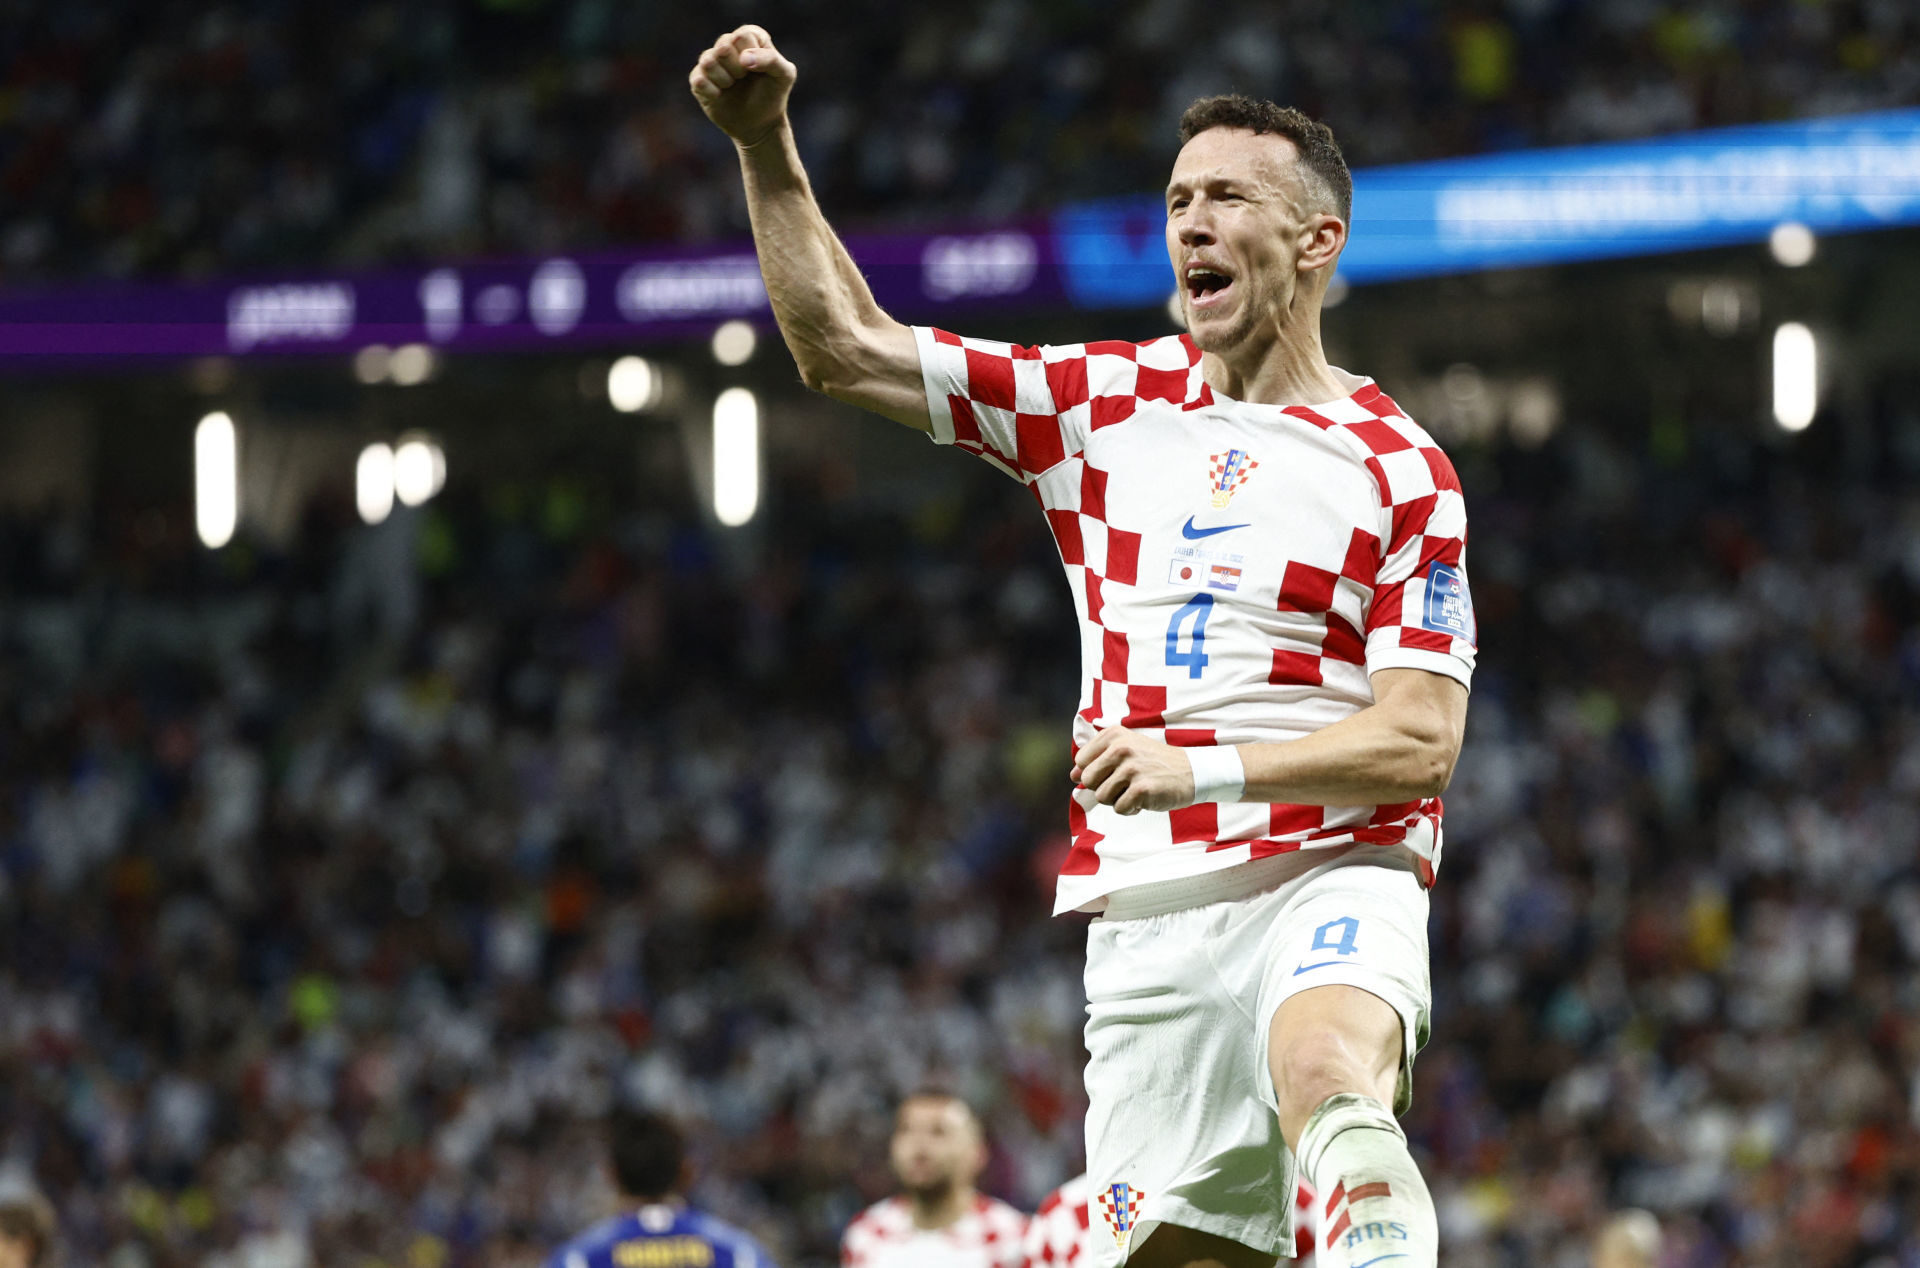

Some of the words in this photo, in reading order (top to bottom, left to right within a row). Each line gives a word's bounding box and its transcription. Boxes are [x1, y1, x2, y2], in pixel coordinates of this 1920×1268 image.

[1165, 592, 1214, 679] 4
[1311, 916, 1359, 955] 4
[1116, 1187, 1126, 1224] HNS
